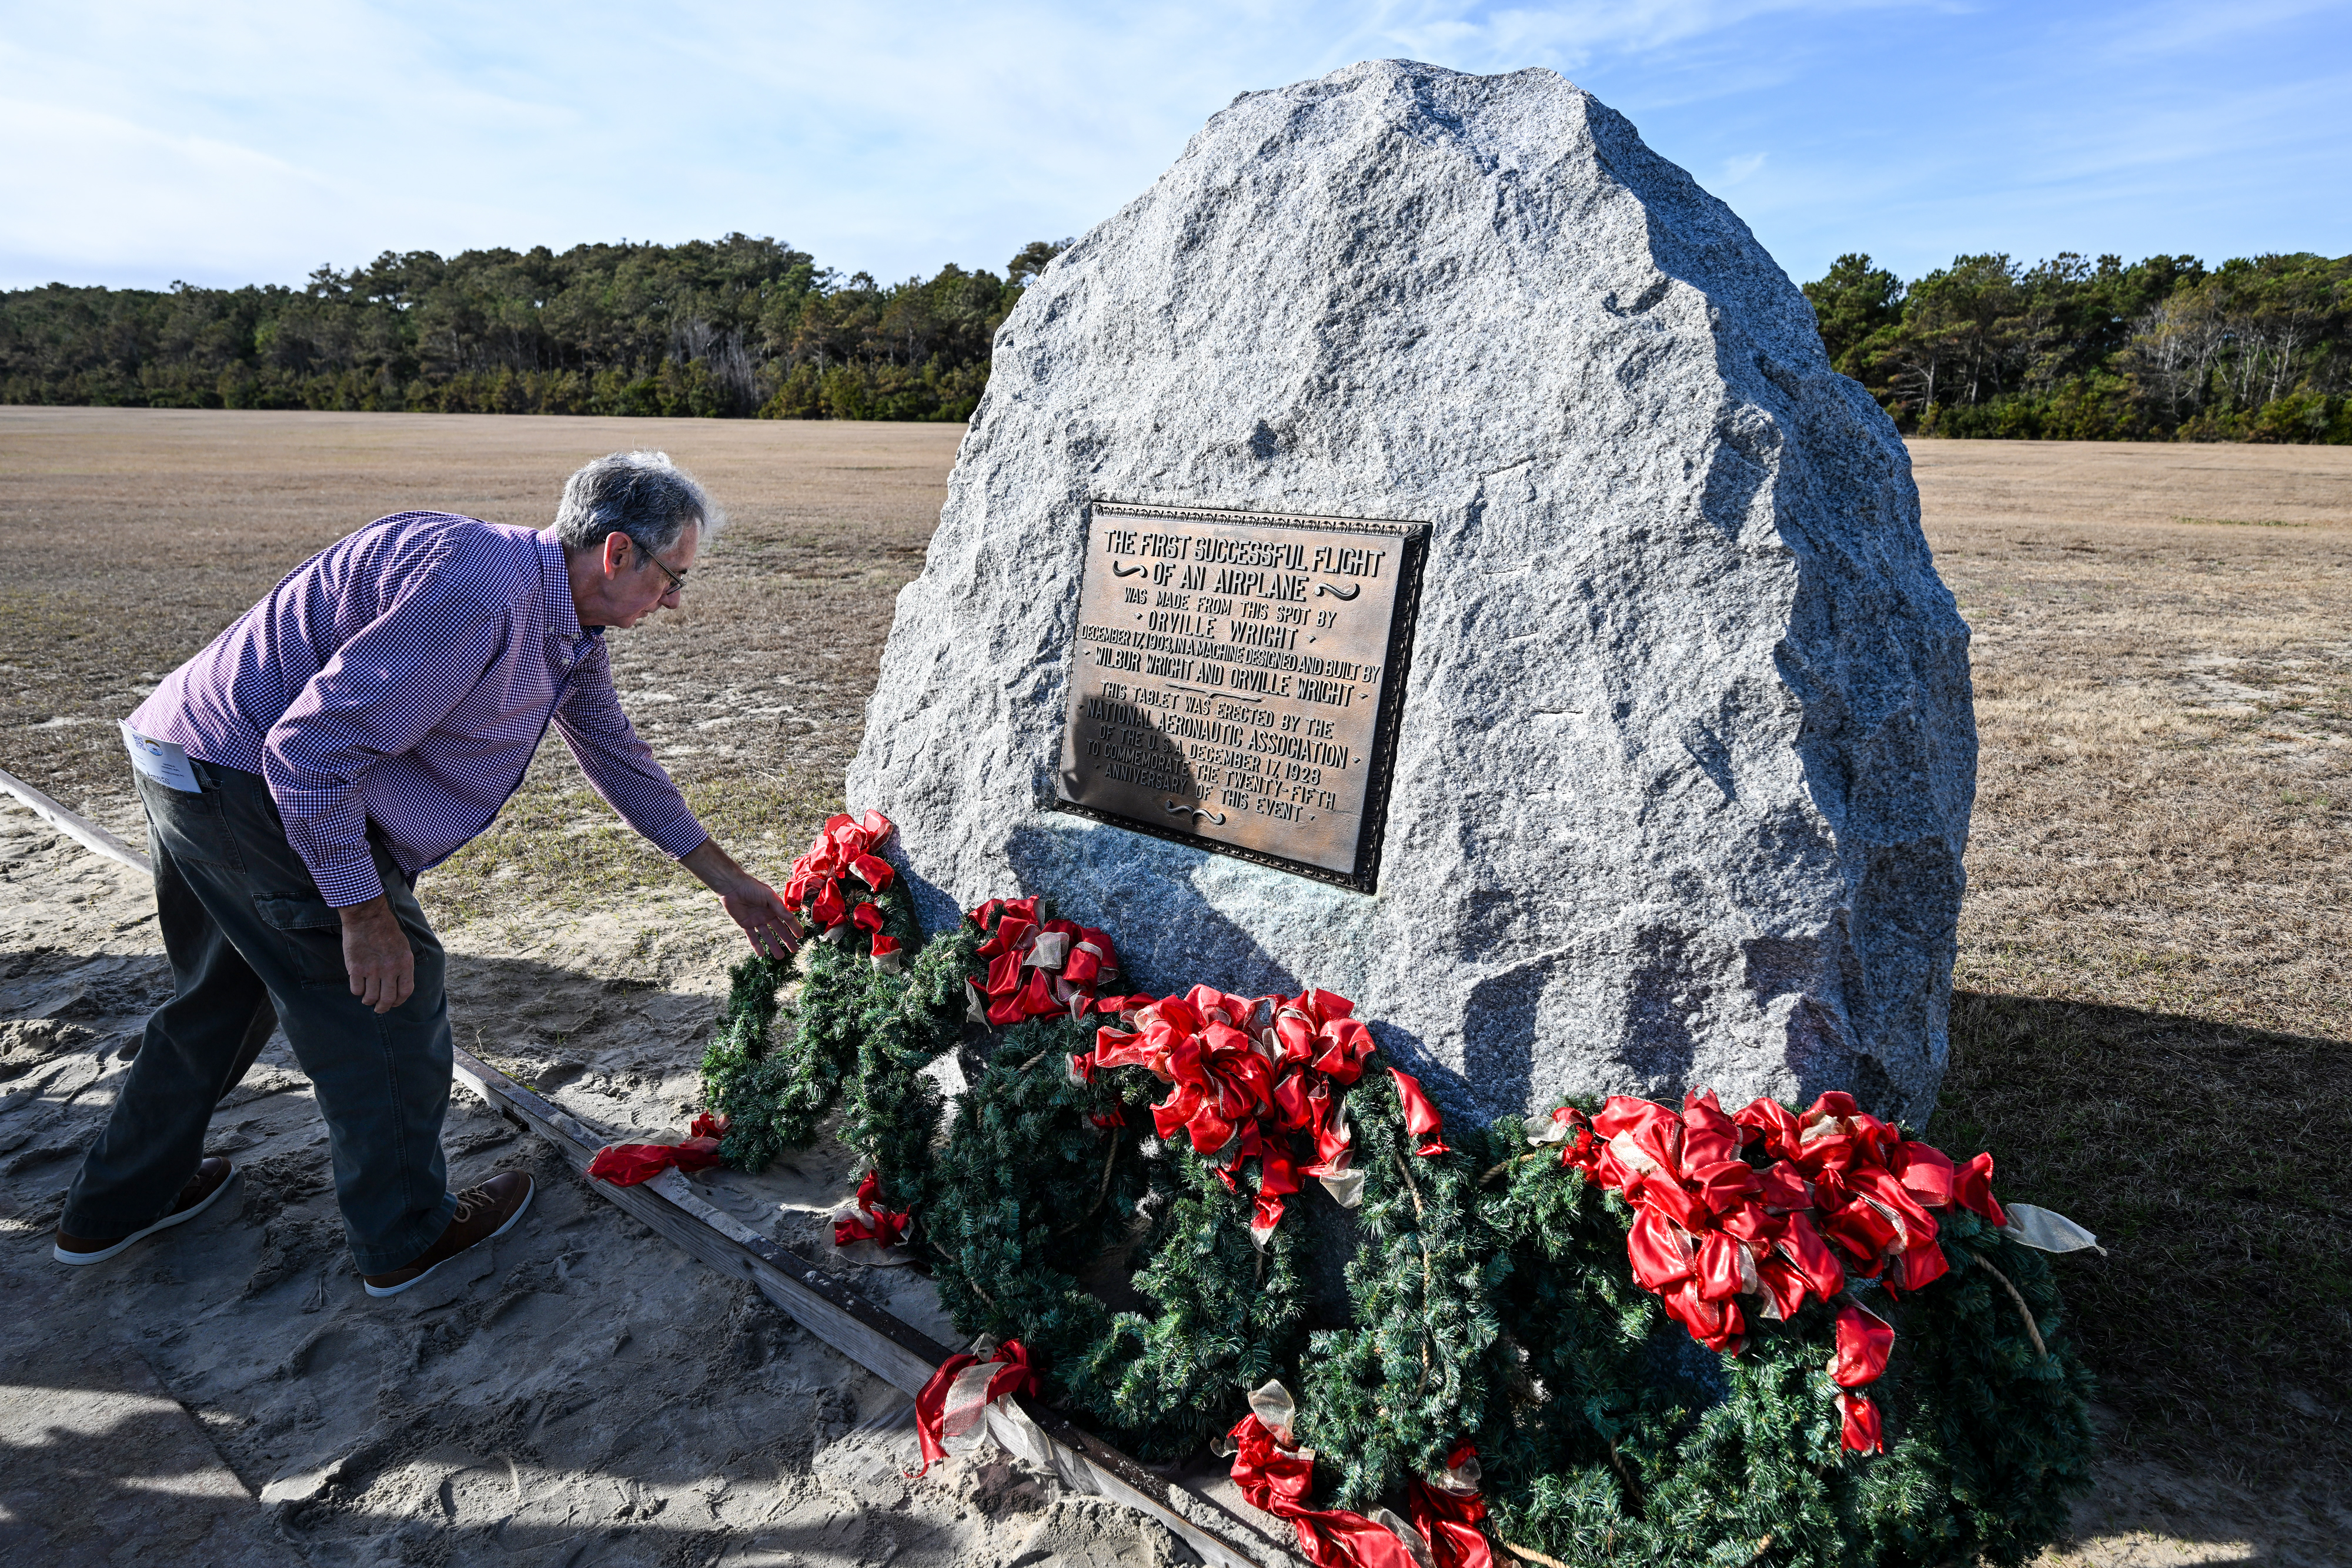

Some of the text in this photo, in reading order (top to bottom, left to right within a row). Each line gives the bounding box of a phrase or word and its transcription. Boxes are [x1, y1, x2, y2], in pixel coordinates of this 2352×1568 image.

[1104, 529, 1385, 577] THE FIRST SUCCESSFUL FLIGHT
[1152, 561, 1309, 601] OF AN AIRPLANE
[1124, 587, 1337, 628] WAS MADE FROM THIS SPOT BY
[1148, 610, 1298, 650] ORVILLE WRIGHT
[1081, 624, 1131, 646] DECEMBER
[1175, 637, 1187, 654] IN
[1186, 639, 1195, 656] A
[1194, 640, 1245, 663] MACHINE
[1245, 647, 1298, 671] DESIGNED
[1297, 655, 1323, 676] AND
[1324, 659, 1361, 681] BUILT
[1362, 664, 1381, 683] BY
[1095, 646, 1355, 707] WILBUR WRIGHT AND ORVILLE WRIGHT
[1087, 698, 1348, 770] NATIONAL AERONAUTIC ASSOCIATION
[1100, 680, 1335, 739] THIS TABLET WAS ERECTED BY THE
[1087, 738, 1336, 810] TO COMMEMORATE THE TWENTY-FIFTH
[1100, 724, 1115, 740] OF
[1120, 728, 1143, 747] THE
[1189, 742, 1261, 773] DECEMBER
[1285, 762, 1321, 785] 1928
[1105, 764, 1303, 823] ANNIVERSARY OF THIS EVENT
